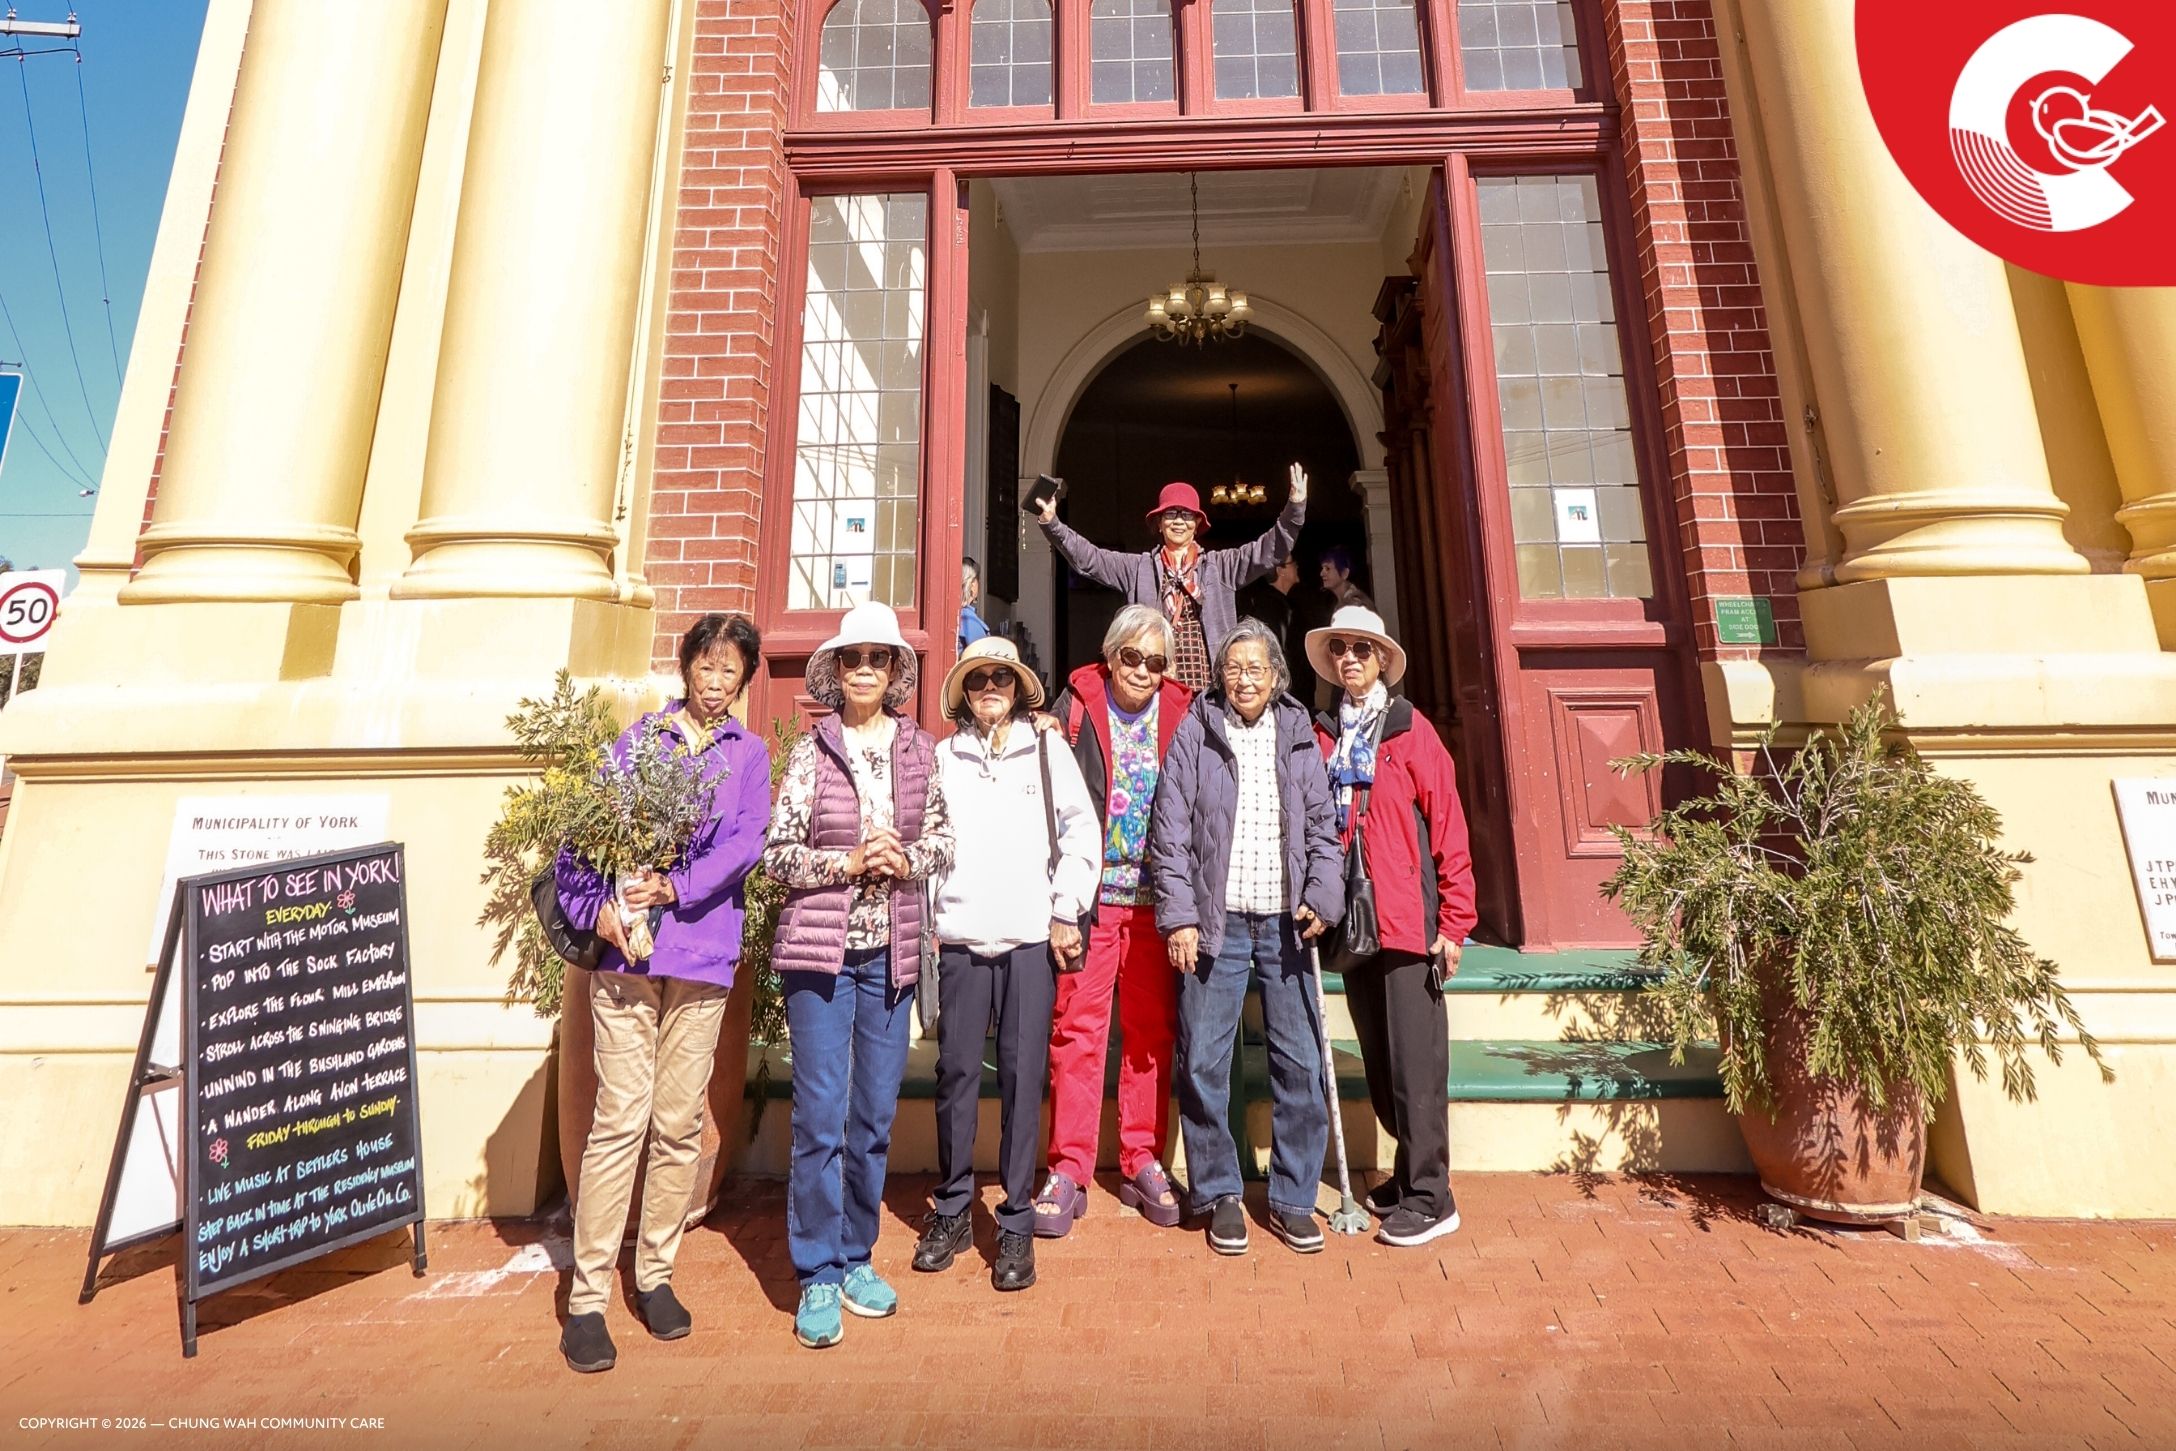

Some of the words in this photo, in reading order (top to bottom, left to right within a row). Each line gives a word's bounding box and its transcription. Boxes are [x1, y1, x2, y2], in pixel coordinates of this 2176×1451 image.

[6, 598, 48, 625] 50
[192, 816, 290, 830] MUNICIPALITY
[295, 817, 312, 830] OF
[319, 815, 359, 829] YORK
[198, 849, 225, 861] THIS
[231, 848, 270, 861] STONE
[277, 849, 301, 860] WAS
[202, 879, 256, 917] WHAT
[258, 874, 279, 904] TO
[285, 869, 319, 897] SEE
[323, 864, 342, 893] IN
[345, 852, 400, 890] YORK!
[209, 936, 255, 963] START
[257, 931, 282, 951] WITH
[283, 928, 306, 946] THE
[309, 918, 349, 940] MOTOR
[352, 907, 399, 931] MUSEUM
[211, 969, 235, 992] POP
[244, 962, 271, 984] INTO
[276, 957, 300, 978] THE
[306, 954, 338, 974] SOCK
[346, 941, 395, 965] FACTORY
[209, 1003, 259, 1030] EXPLORE
[263, 996, 285, 1013] THE
[290, 988, 325, 1008] FLOUR
[332, 982, 359, 999] MILL
[362, 970, 406, 994] EMPORIUM
[206, 1040, 245, 1063] STROLL
[250, 1031, 285, 1051] ACROSS
[286, 1025, 304, 1044] THE
[308, 1012, 362, 1037] SWINGING
[365, 1005, 403, 1028] BRIDGE
[204, 1070, 256, 1099] UNWIND
[262, 1066, 275, 1083] IN
[278, 1060, 303, 1078] THE
[309, 1050, 364, 1075] BUSHLAND
[367, 1036, 406, 1060] GARDENS
[207, 1118, 218, 1135] A
[224, 1099, 276, 1129] WANDER
[283, 1089, 322, 1113] ALONG
[330, 1077, 358, 1101] AVON
[361, 1067, 407, 1091] TERRACE
[246, 1123, 291, 1150] FRIDAY
[292, 1112, 341, 1136] THROUGH
[359, 1095, 397, 1118] SUNDAY
[198, 1217, 224, 1242] STEP
[226, 1208, 253, 1232] BACK
[255, 1202, 266, 1222] IN
[267, 1198, 292, 1218] TIME
[293, 1191, 308, 1210] AT
[309, 1185, 330, 1203] THE
[334, 1166, 379, 1195] RESIDENCY
[381, 1154, 415, 1179] MUSEUM
[208, 1181, 232, 1205] LIVE
[234, 1171, 272, 1195] MUSIC
[275, 1164, 291, 1184] AT
[297, 1148, 349, 1180] SETTLERS
[356, 1132, 393, 1160] HOUSE
[199, 1240, 236, 1273] ENJOY
[240, 1238, 249, 1257] A
[324, 1206, 348, 1234] YORK
[350, 1193, 376, 1217] OLIVE
[376, 1188, 394, 1208] OIL
